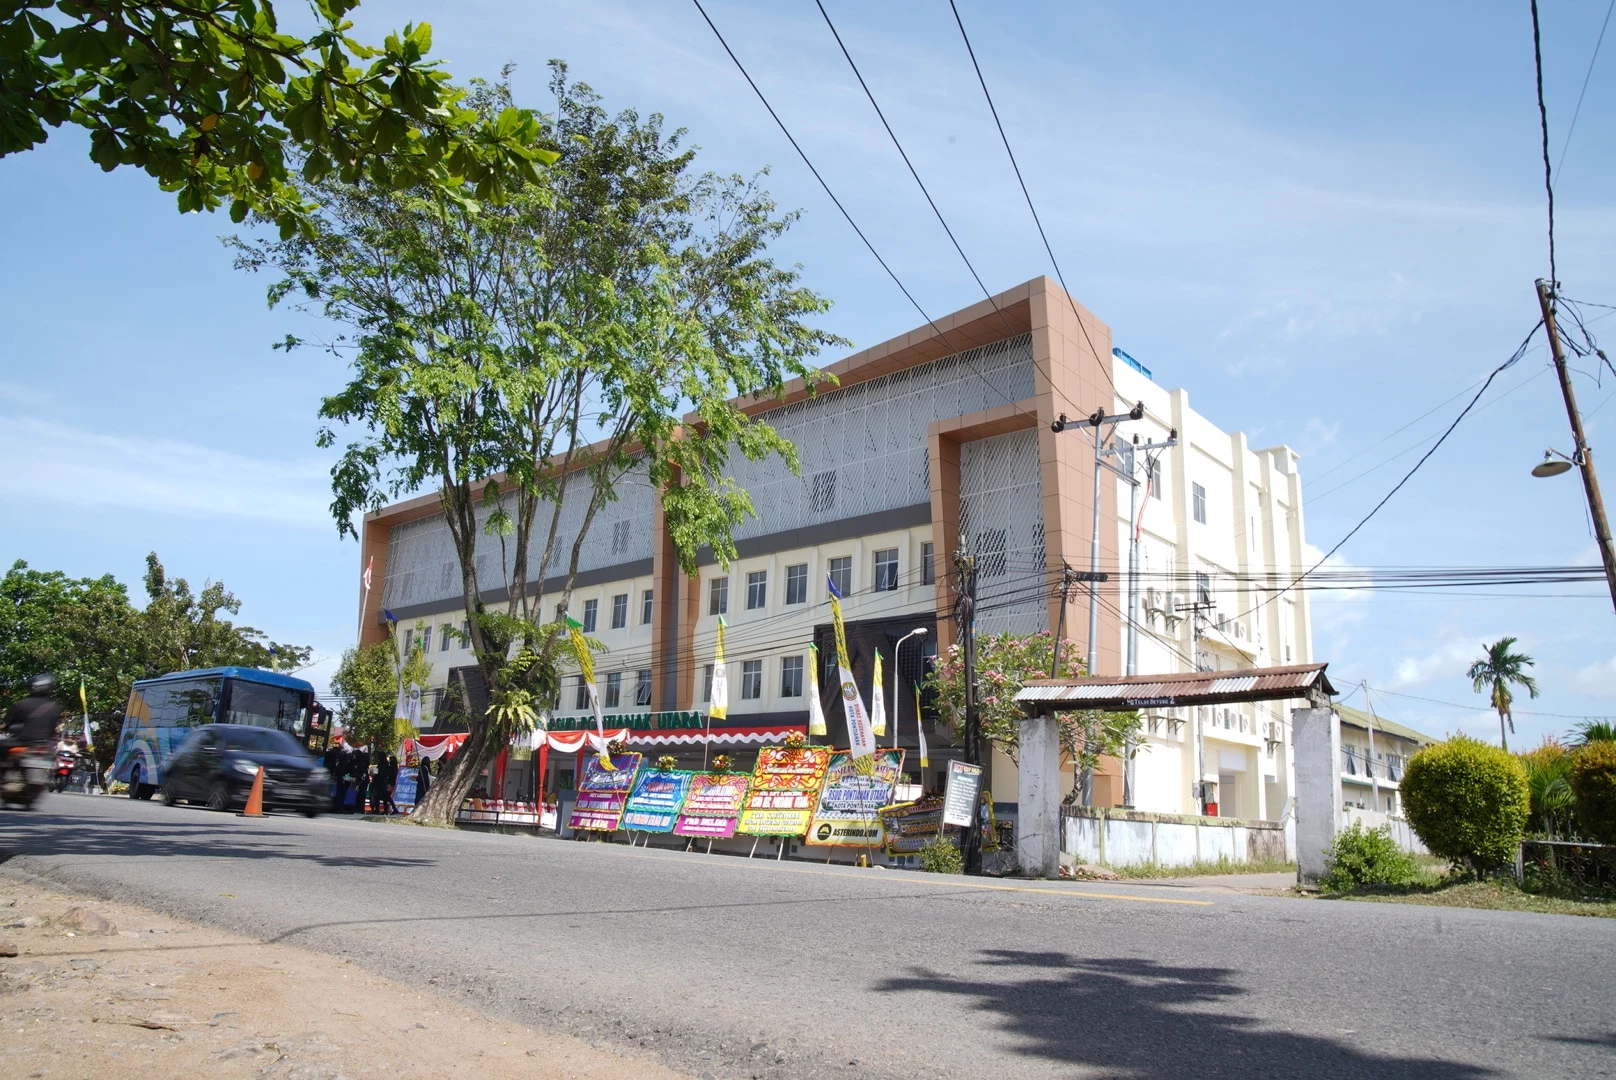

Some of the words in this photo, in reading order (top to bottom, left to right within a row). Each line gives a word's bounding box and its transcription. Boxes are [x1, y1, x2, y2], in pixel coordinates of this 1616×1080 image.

[1169, 696, 1175, 704] 2
[657, 710, 703, 728] UTARA
[851, 719, 860, 746] PONTIANAK
[870, 789, 886, 800] UTARA
